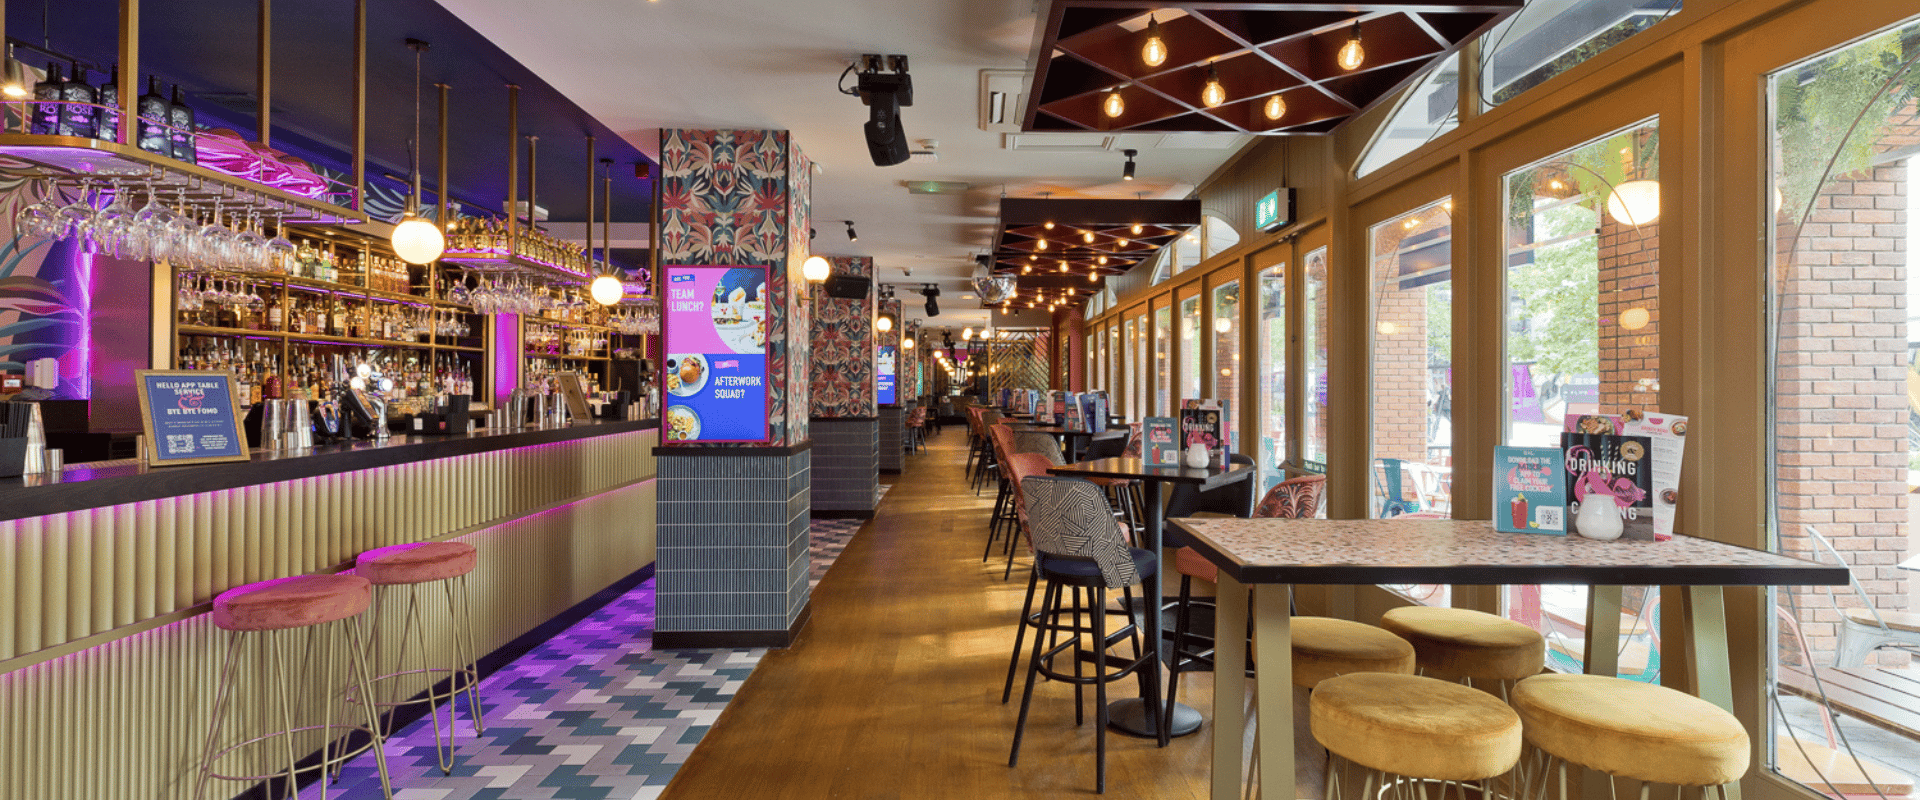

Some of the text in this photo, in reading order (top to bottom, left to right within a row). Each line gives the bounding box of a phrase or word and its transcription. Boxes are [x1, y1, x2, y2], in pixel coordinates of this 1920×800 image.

[671, 289, 694, 299] TEAM
[671, 301, 704, 312] LUNCH?
[714, 376, 762, 387] AFTERWORK
[174, 388, 204, 396] SERVICE
[714, 388, 746, 399] SQUAD?
[197, 407, 219, 415] FOMO
[1507, 456, 1551, 465] DOWNLOAD THE
[1570, 457, 1637, 476] DRINKING
